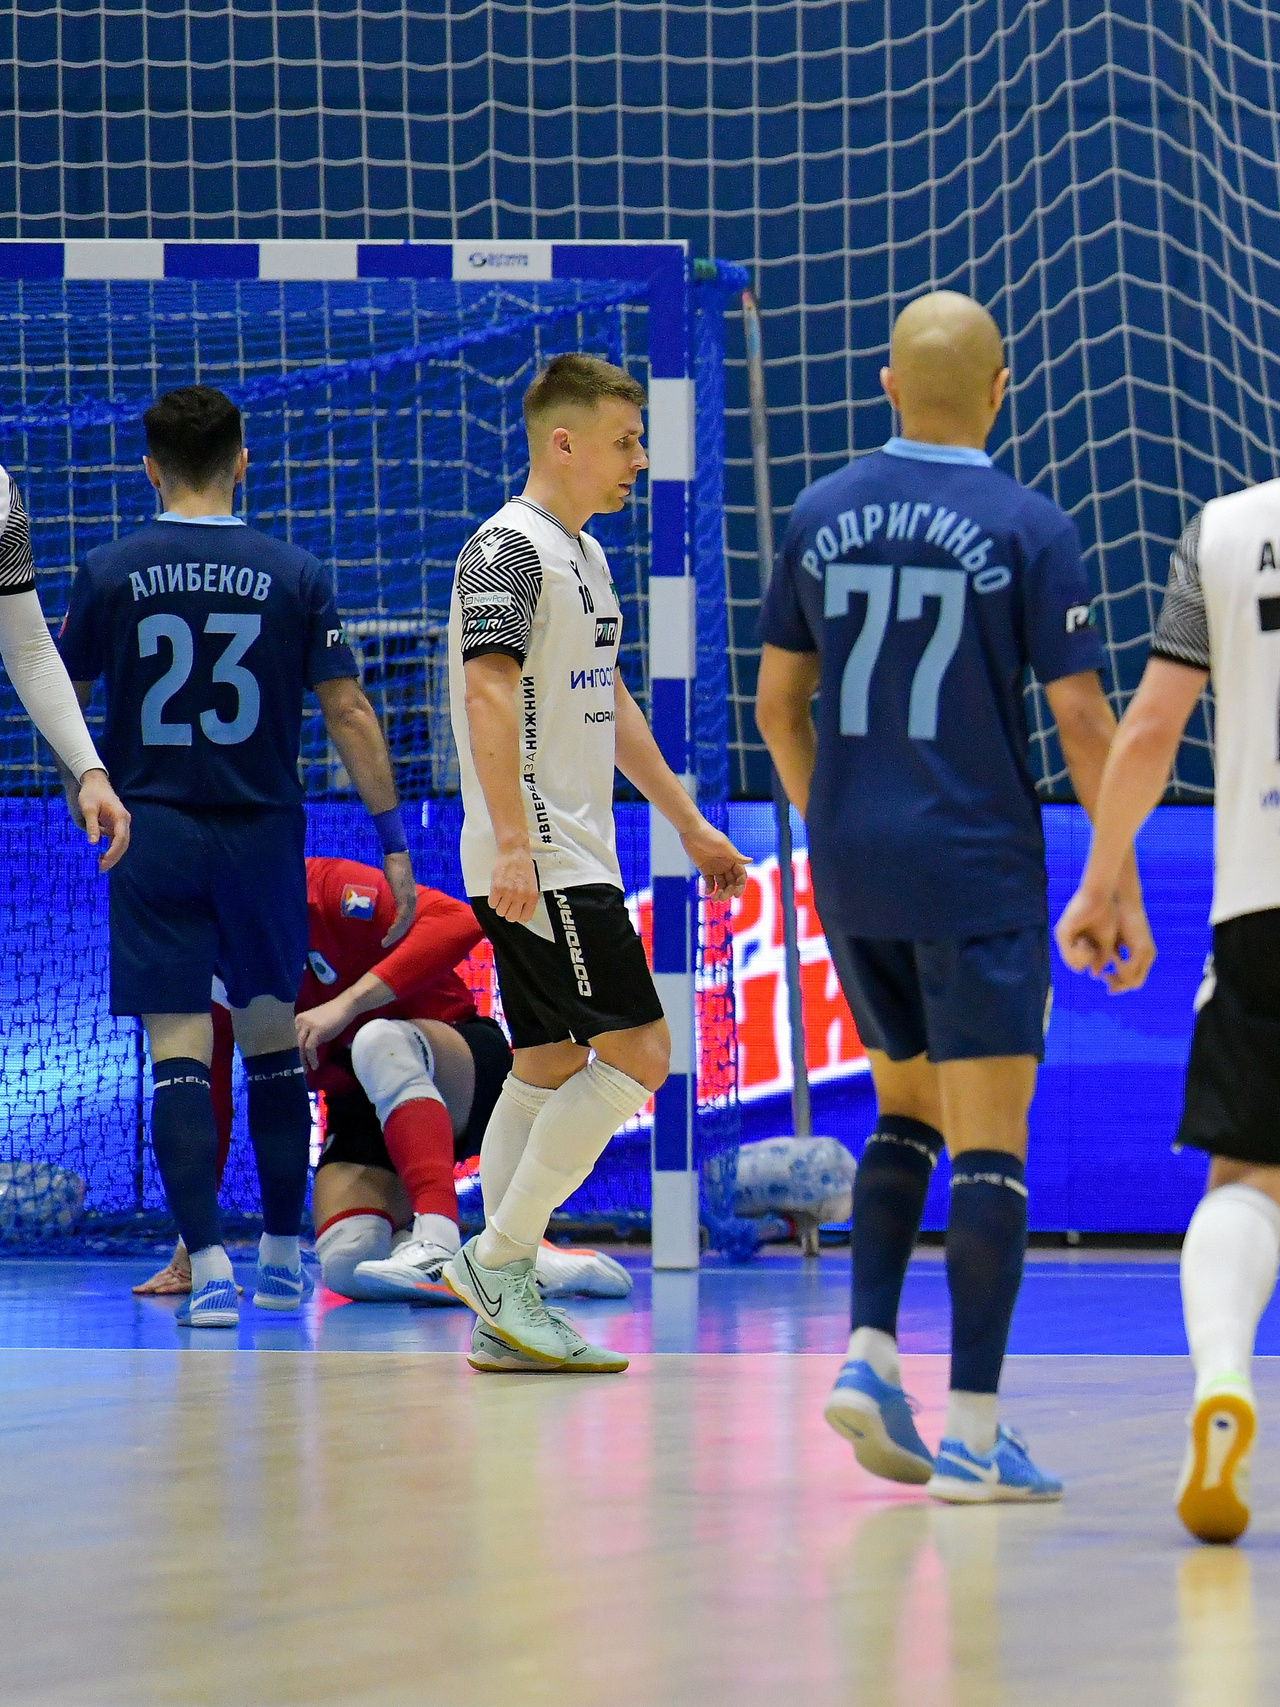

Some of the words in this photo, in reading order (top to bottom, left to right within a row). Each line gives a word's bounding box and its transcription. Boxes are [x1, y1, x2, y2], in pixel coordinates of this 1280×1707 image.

[128, 563, 272, 601] АЛИБЕКОВ
[801, 501, 1013, 595] РОДРИГИНЬО
[578, 584, 595, 614] 10
[137, 613, 262, 746] 23
[824, 563, 968, 741] 77
